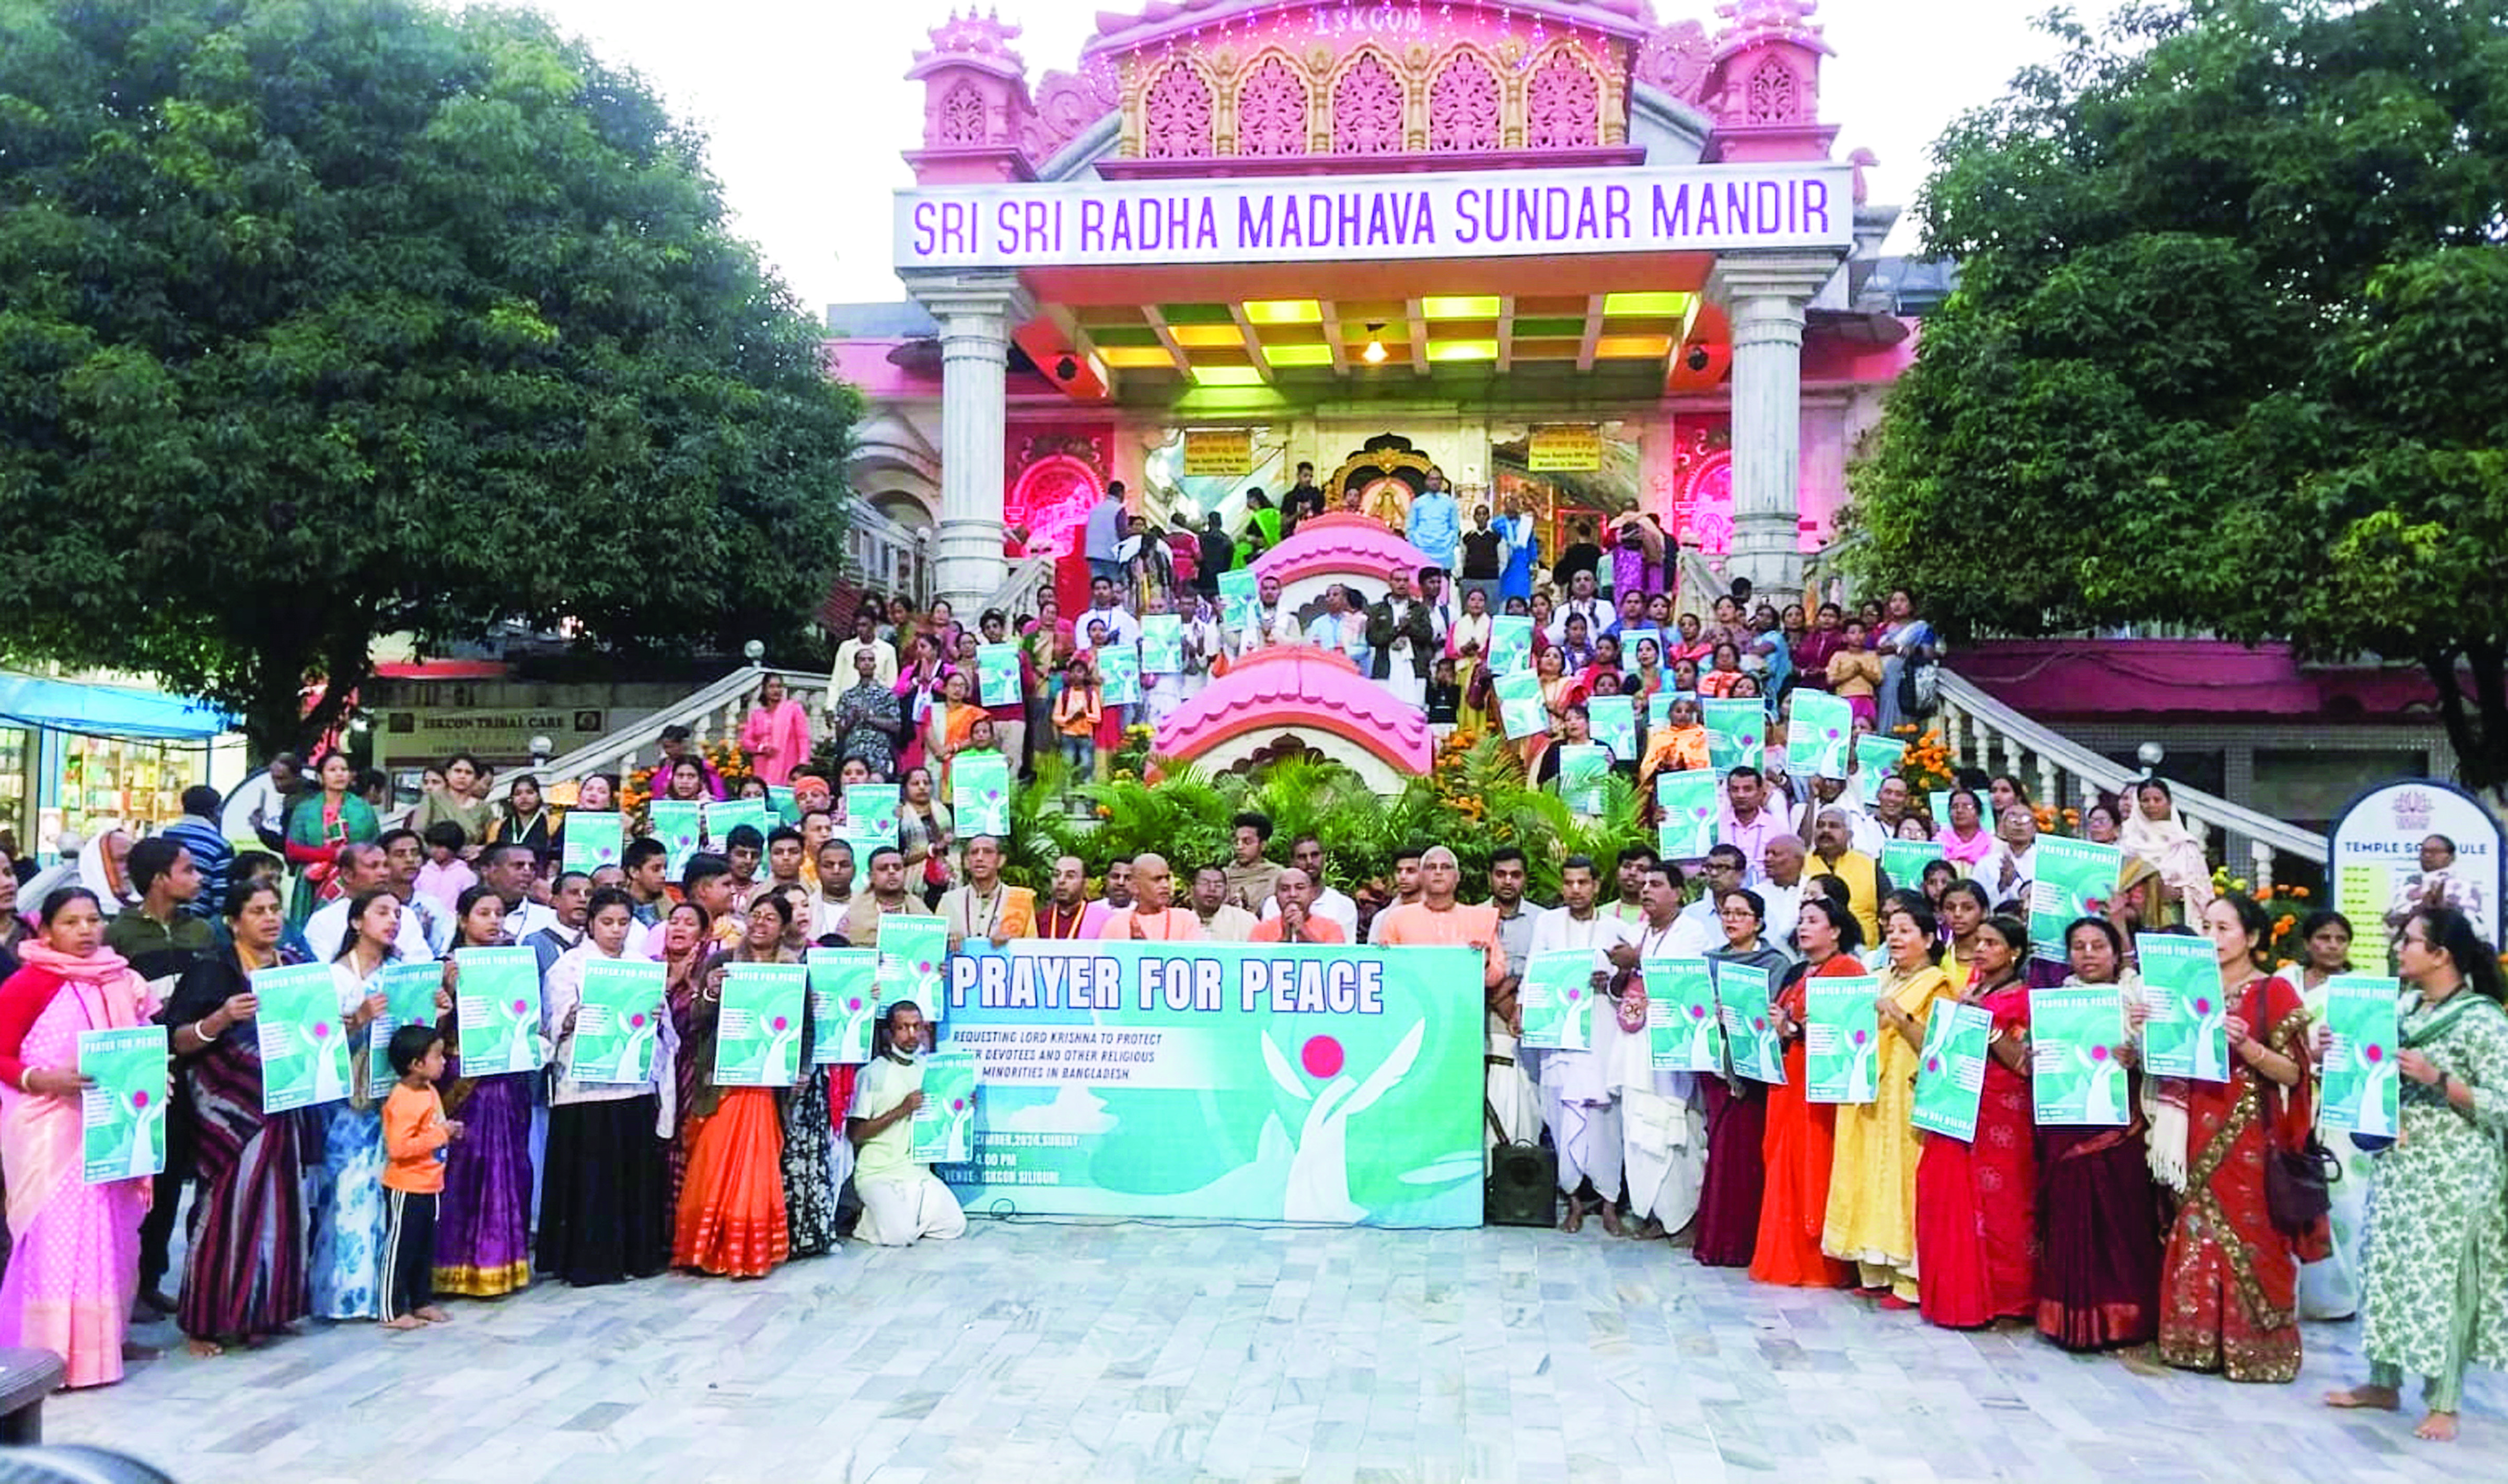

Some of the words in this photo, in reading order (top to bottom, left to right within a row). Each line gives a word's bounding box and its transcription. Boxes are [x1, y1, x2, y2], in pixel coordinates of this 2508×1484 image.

[1314, 7, 1421, 36] ISKCON
[914, 202, 978, 255] SRI
[997, 200, 1062, 254] SRI
[1081, 196, 1218, 251] RADHA
[1238, 191, 1435, 248] MADHAVA
[1456, 185, 1631, 243] SUNDAR
[1652, 179, 1829, 238] MANDIR
[2039, 843, 2071, 858] PRAYER
[2073, 848, 2089, 860] FOR
[2092, 851, 2118, 866] PEACE
[2344, 842, 2399, 853] TEMPLE
[2405, 843, 2487, 855] SCULE
[620, 968, 636, 978] FOR
[950, 956, 1121, 1010] PRAYER
[1139, 958, 1223, 1011] FOR
[1241, 960, 1383, 1014] PEACE
[2071, 997, 2088, 1007] FOR
[118, 1038, 134, 1049] FOR
[954, 1031, 1017, 1043] REQUESTING
[1020, 1032, 1046, 1044] LORD
[1050, 1032, 1097, 1044] KRISHNA
[1101, 1033, 1113, 1045] TO
[1117, 1033, 1163, 1045] PROTECT
[985, 1049, 1036, 1061] DEVOTEES
[1039, 1049, 1061, 1061] AND
[1064, 1050, 1097, 1061] OTHER
[1101, 1050, 1155, 1062] RELIGIOUS
[983, 1066, 1043, 1078] MINORITIES
[1047, 1067, 1058, 1078] IN
[1000, 1153, 1016, 1166] PM
